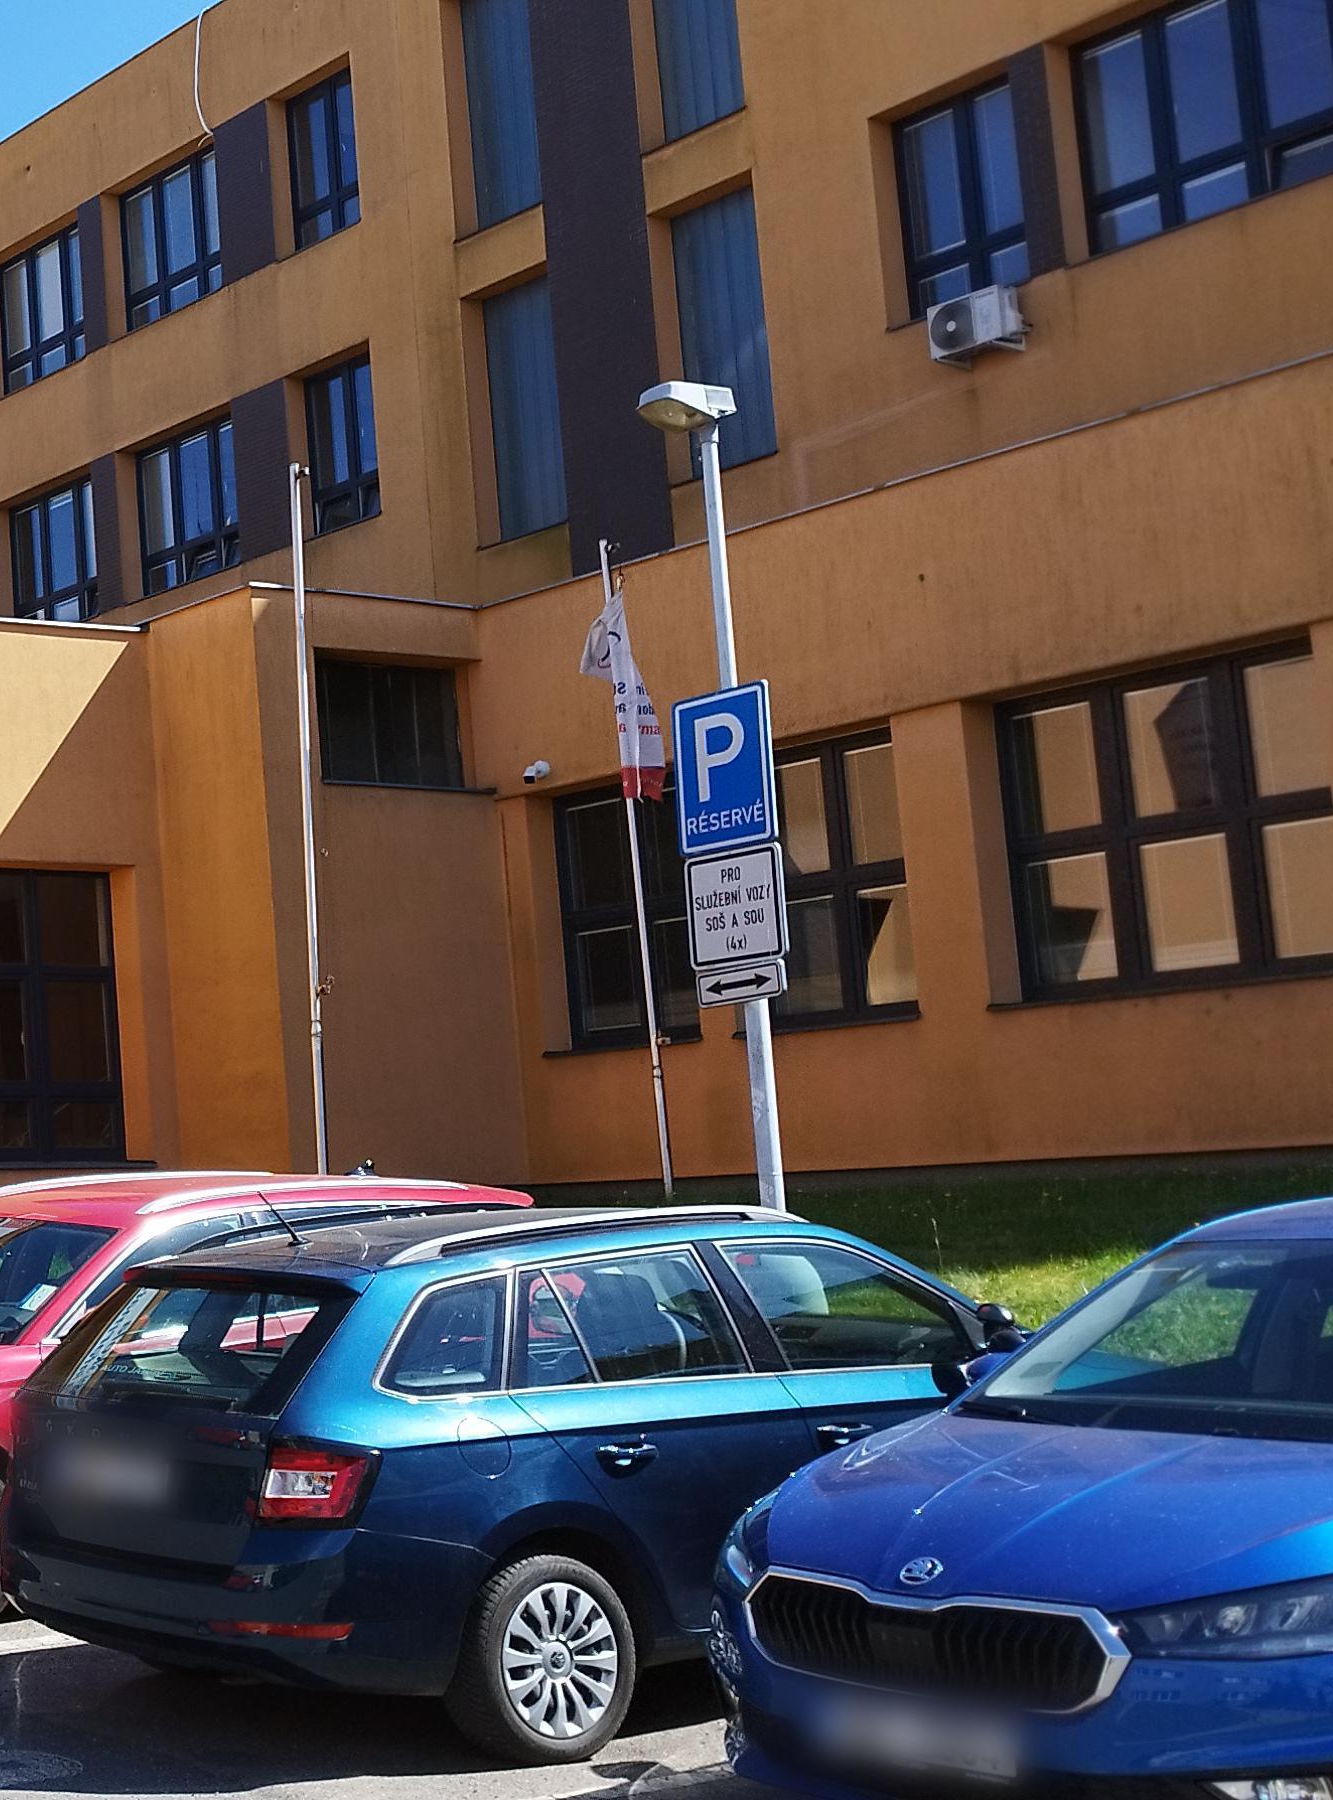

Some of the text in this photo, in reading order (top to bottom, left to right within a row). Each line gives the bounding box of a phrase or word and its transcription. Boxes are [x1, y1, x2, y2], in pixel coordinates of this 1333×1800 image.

[693, 712, 745, 803] P
[686, 798, 764, 837] RÉSERVÉ
[720, 866, 741, 884] PRO
[694, 883, 771, 911] SLUŽEBNÍ VOZY
[705, 908, 765, 932] SOŠ A SOU
[726, 934, 747, 952] (4x)
